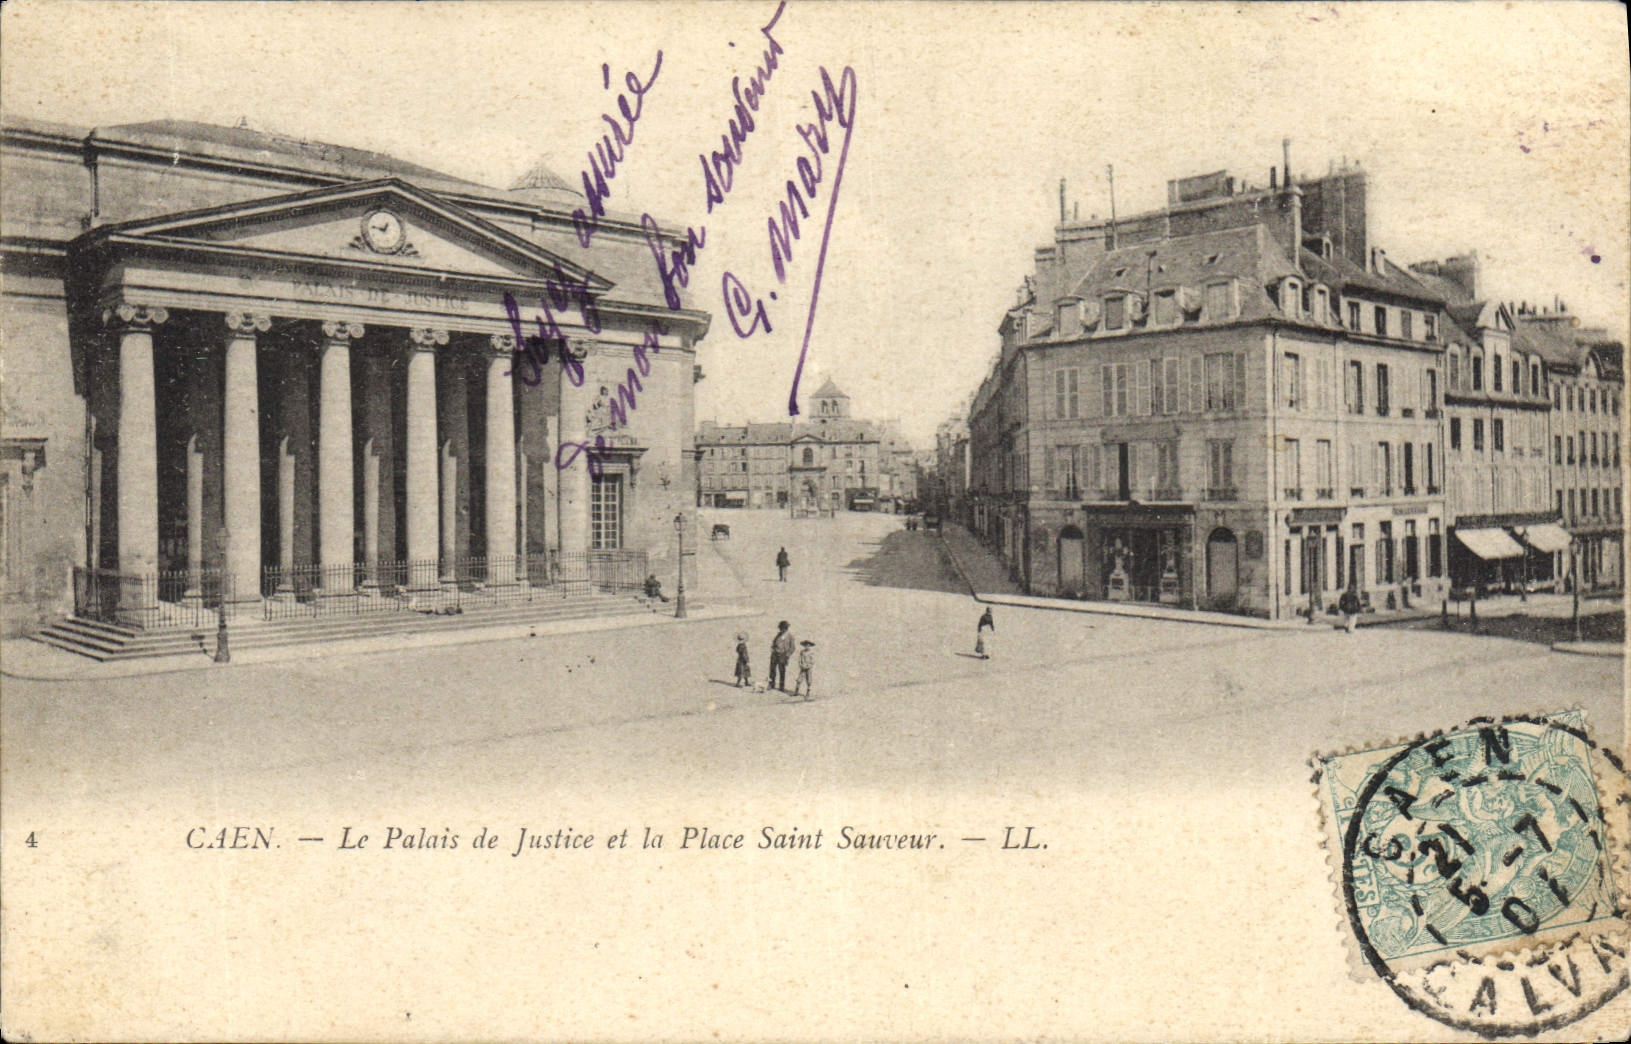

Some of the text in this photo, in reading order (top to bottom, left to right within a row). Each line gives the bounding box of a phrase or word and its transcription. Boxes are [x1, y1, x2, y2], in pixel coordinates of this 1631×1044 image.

[571, 50, 663, 249] assurée
[291, 280, 470, 312] PALAIS DE JUSTICE
[609, 320, 669, 432] mon
[1362, 726, 1511, 861] CAEN
